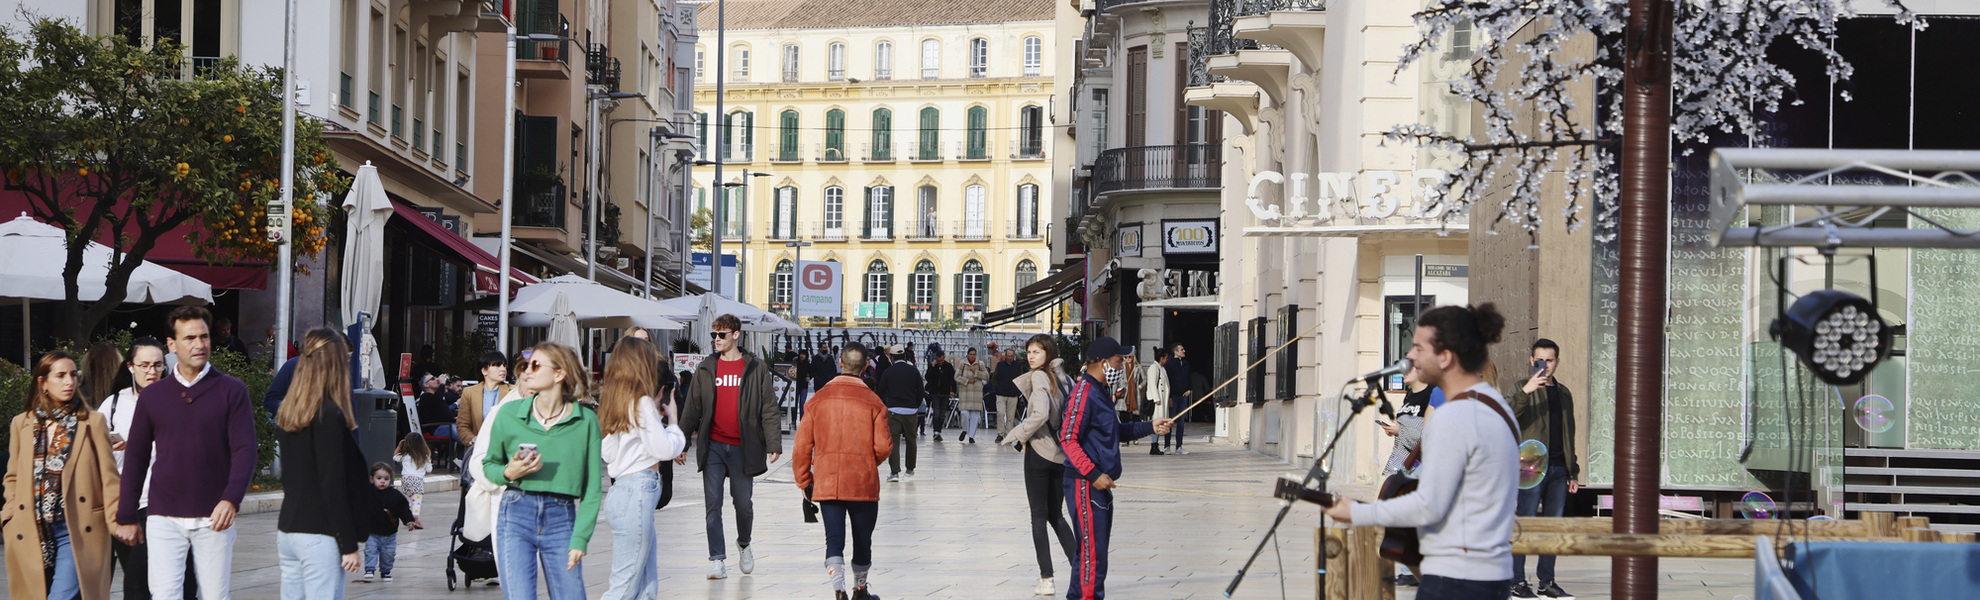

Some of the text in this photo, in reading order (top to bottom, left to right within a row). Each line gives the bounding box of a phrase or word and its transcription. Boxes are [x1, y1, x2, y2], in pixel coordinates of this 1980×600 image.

[1245, 169, 1447, 220] CINES
[1124, 232, 1136, 245] 100
[1175, 228, 1204, 241] 100
[802, 295, 833, 305] campano
